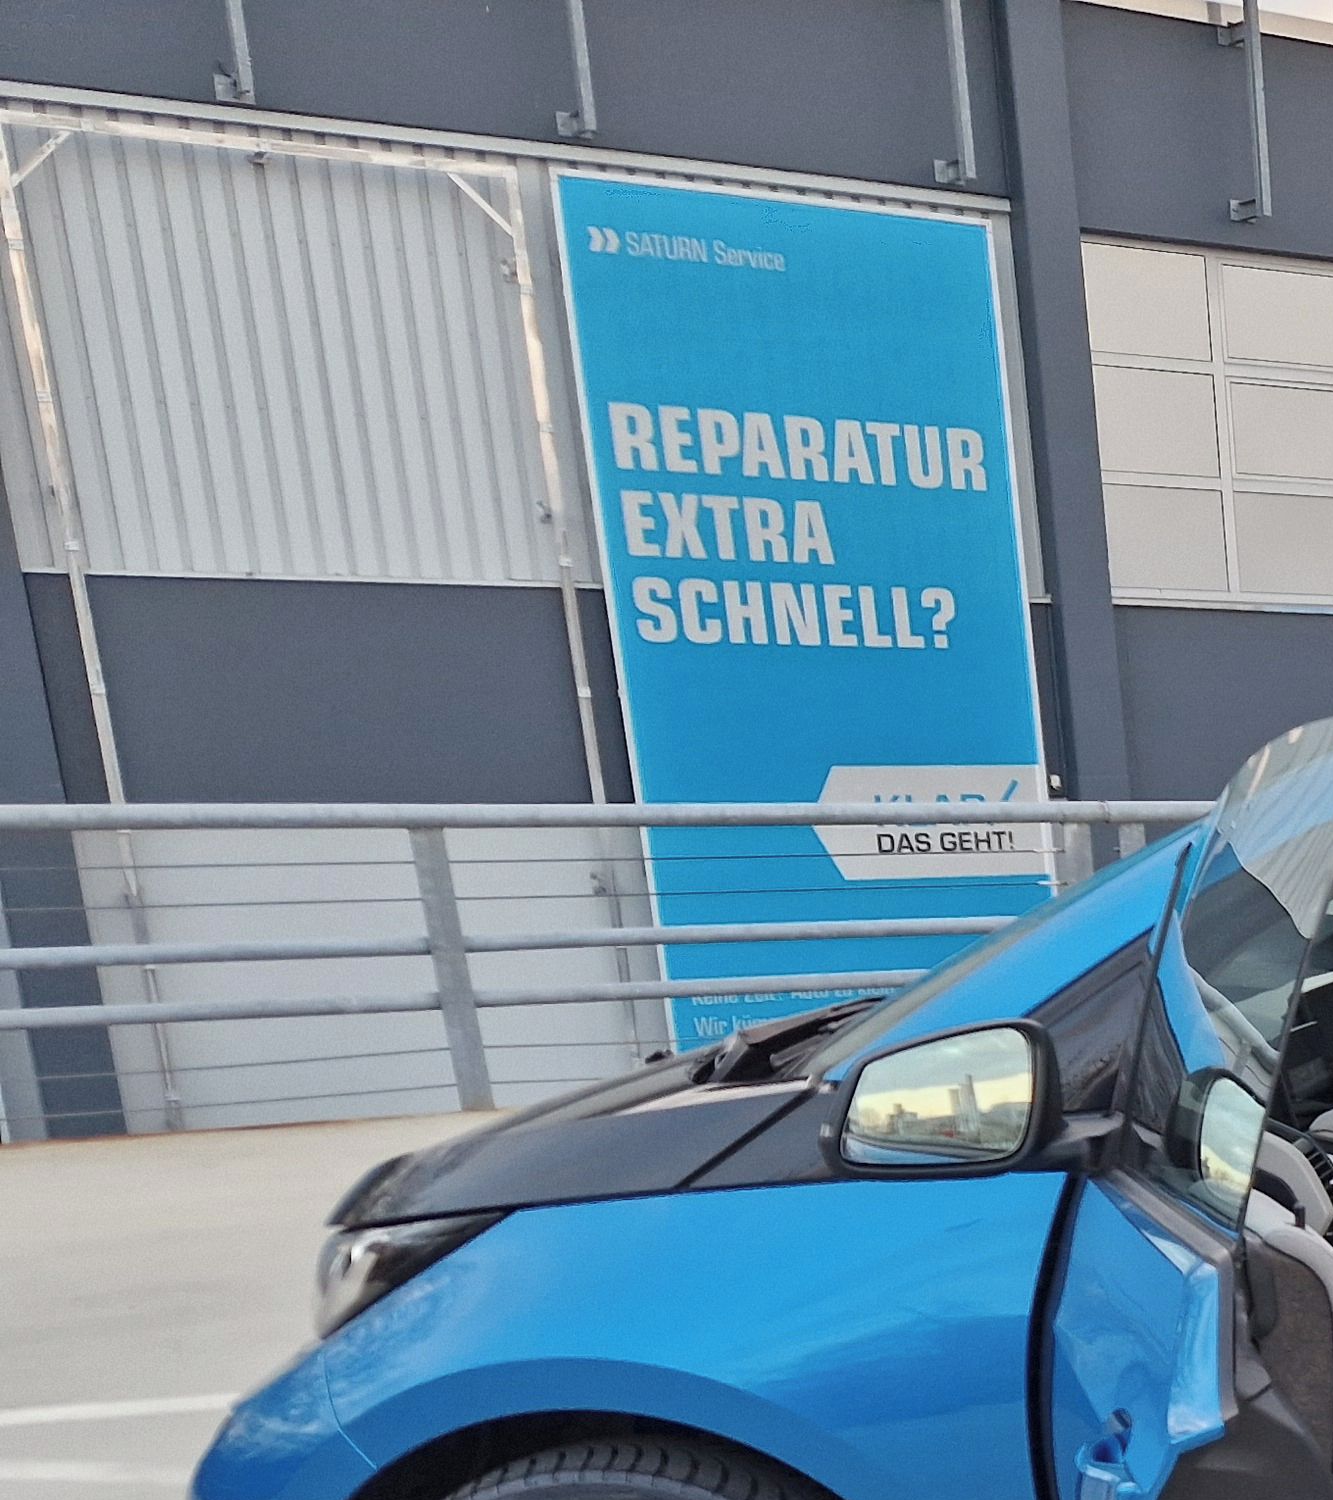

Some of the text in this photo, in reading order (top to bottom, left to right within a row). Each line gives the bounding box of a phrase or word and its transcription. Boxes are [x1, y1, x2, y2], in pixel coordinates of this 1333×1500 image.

[625, 230, 787, 272] SATURN Service
[607, 401, 987, 491] REPARATUR
[618, 489, 835, 565] EXTRA
[631, 575, 957, 649] SCHNELL?
[876, 831, 1014, 853] DAS GEHT!
[693, 1015, 728, 1037] Wir
